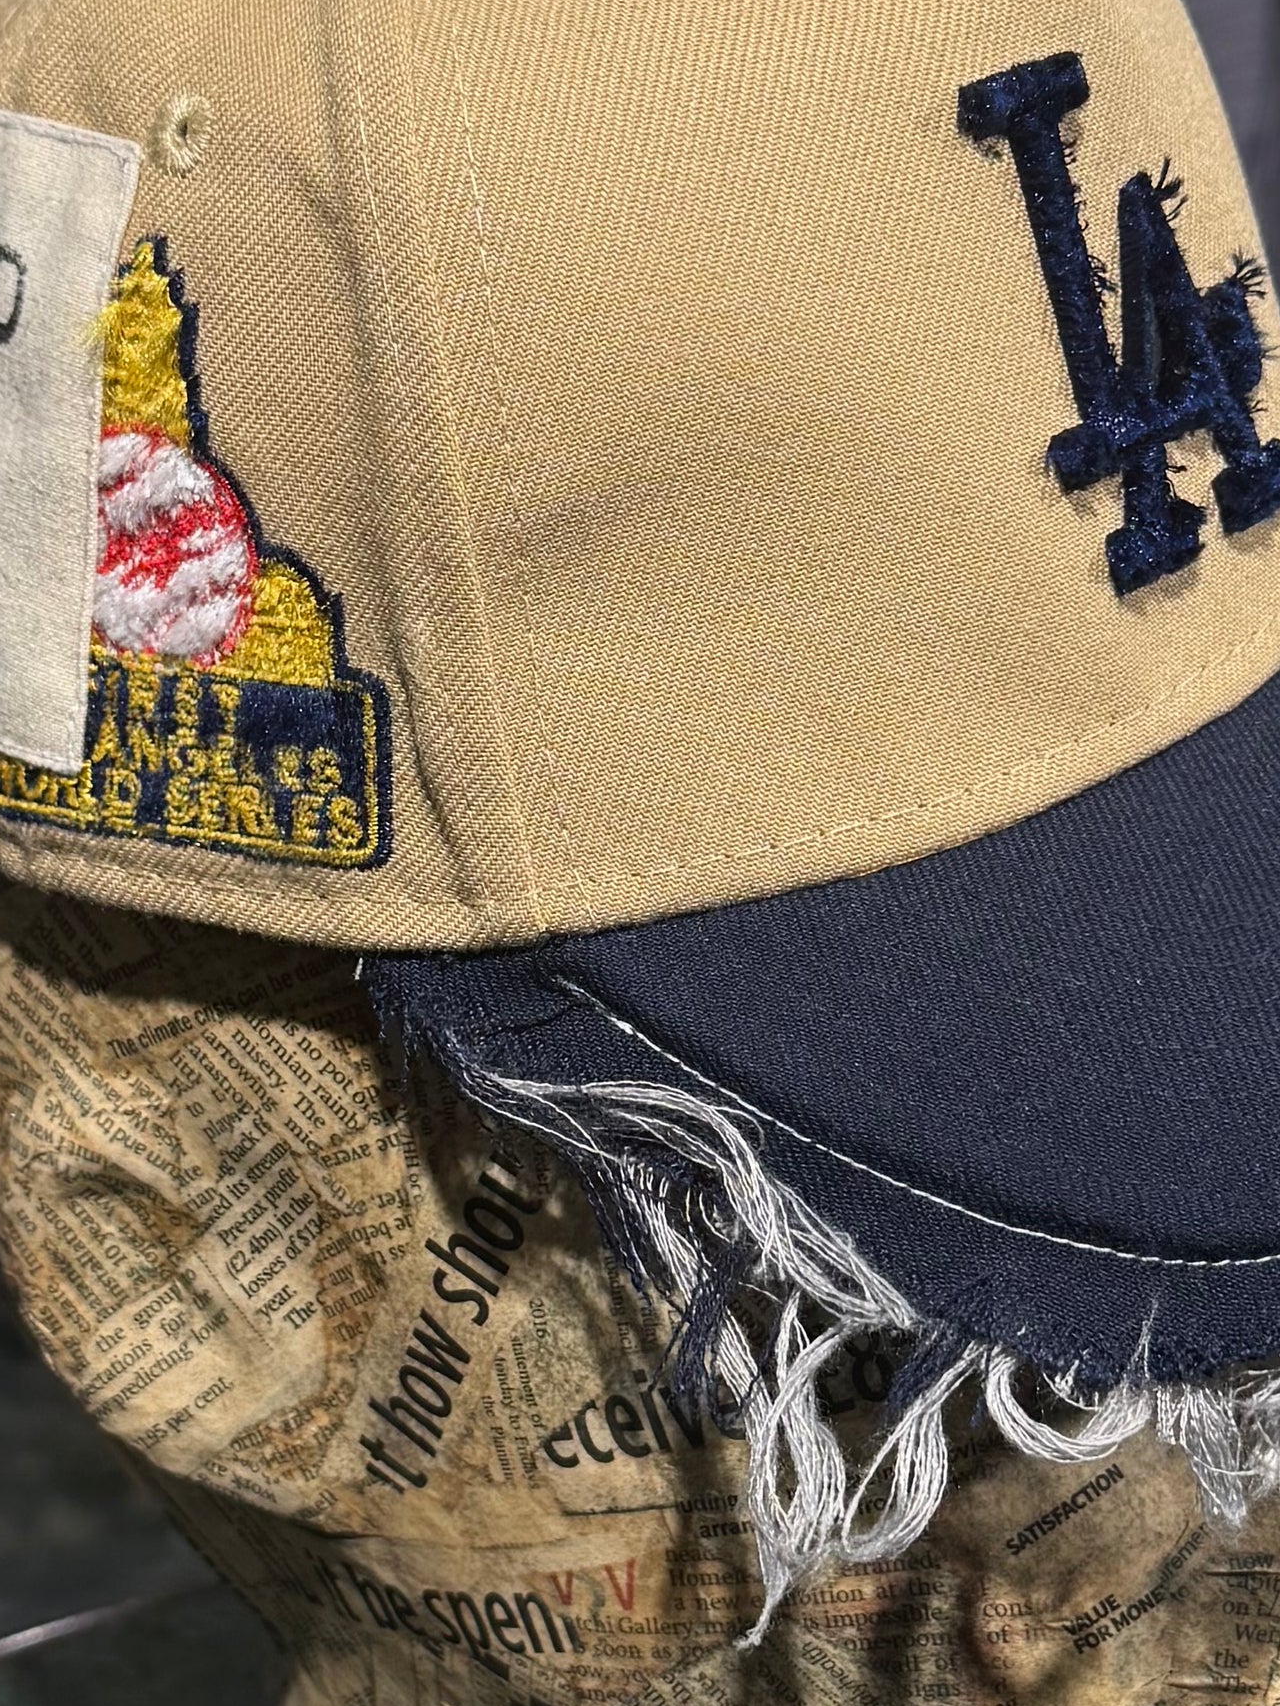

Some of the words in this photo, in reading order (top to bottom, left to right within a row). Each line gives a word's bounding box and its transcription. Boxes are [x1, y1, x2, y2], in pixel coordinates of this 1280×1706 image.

[165, 774, 364, 850] SERIES
[0, 984, 47, 1027] most
[3, 962, 66, 1019] leaving
[16, 1029, 58, 1067] who
[32, 1017, 103, 1079] stripped
[106, 1032, 139, 1063] The
[133, 1010, 197, 1051] climate
[190, 991, 239, 1026] crisis
[36, 1056, 103, 1119] families
[223, 1026, 295, 1098] misery.
[288, 1089, 331, 1132] The
[295, 1034, 325, 1064] no
[315, 1057, 355, 1097] pot
[78, 1067, 130, 1114] have
[184, 1097, 206, 1120] to
[85, 1103, 120, 1138] try
[107, 1123, 149, 1162] and
[223, 1127, 264, 1166] back
[227, 1177, 252, 1201] its
[241, 1135, 294, 1184] stream
[217, 1199, 271, 1248] Pre-tax
[258, 1164, 304, 1209] profit
[31, 1184, 130, 1316] installations,
[102, 1239, 130, 1270] 10
[220, 1220, 287, 1281] (£2.4bn)
[274, 1208, 295, 1229] in
[286, 1189, 315, 1217] the
[123, 1263, 147, 1289] as
[237, 1252, 289, 1300] losses
[279, 1236, 304, 1261] of
[157, 1308, 193, 1340] for
[254, 1280, 301, 1324] year.
[281, 1295, 319, 1331] The
[528, 1298, 551, 1338] 2016
[92, 1322, 131, 1357] the
[103, 1335, 201, 1412] predicting
[368, 1308, 472, 1459] how
[510, 1335, 538, 1408] statement
[164, 1404, 199, 1436] per
[1004, 1463, 1125, 1556] SATISFACTION
[340, 1561, 425, 1636] be
[695, 1595, 740, 1611] new
[875, 1581, 899, 1600] at
[907, 1577, 945, 1597] the
[1062, 1594, 1122, 1636] VALUE
[620, 1616, 695, 1636] Gallery,
[1072, 1625, 1113, 1655] FOR
[1114, 1585, 1166, 1633] MONE
[592, 1641, 643, 1658] soon
[651, 1644, 674, 1658] as
[1213, 1648, 1250, 1670] the
[656, 1668, 695, 1705] the
